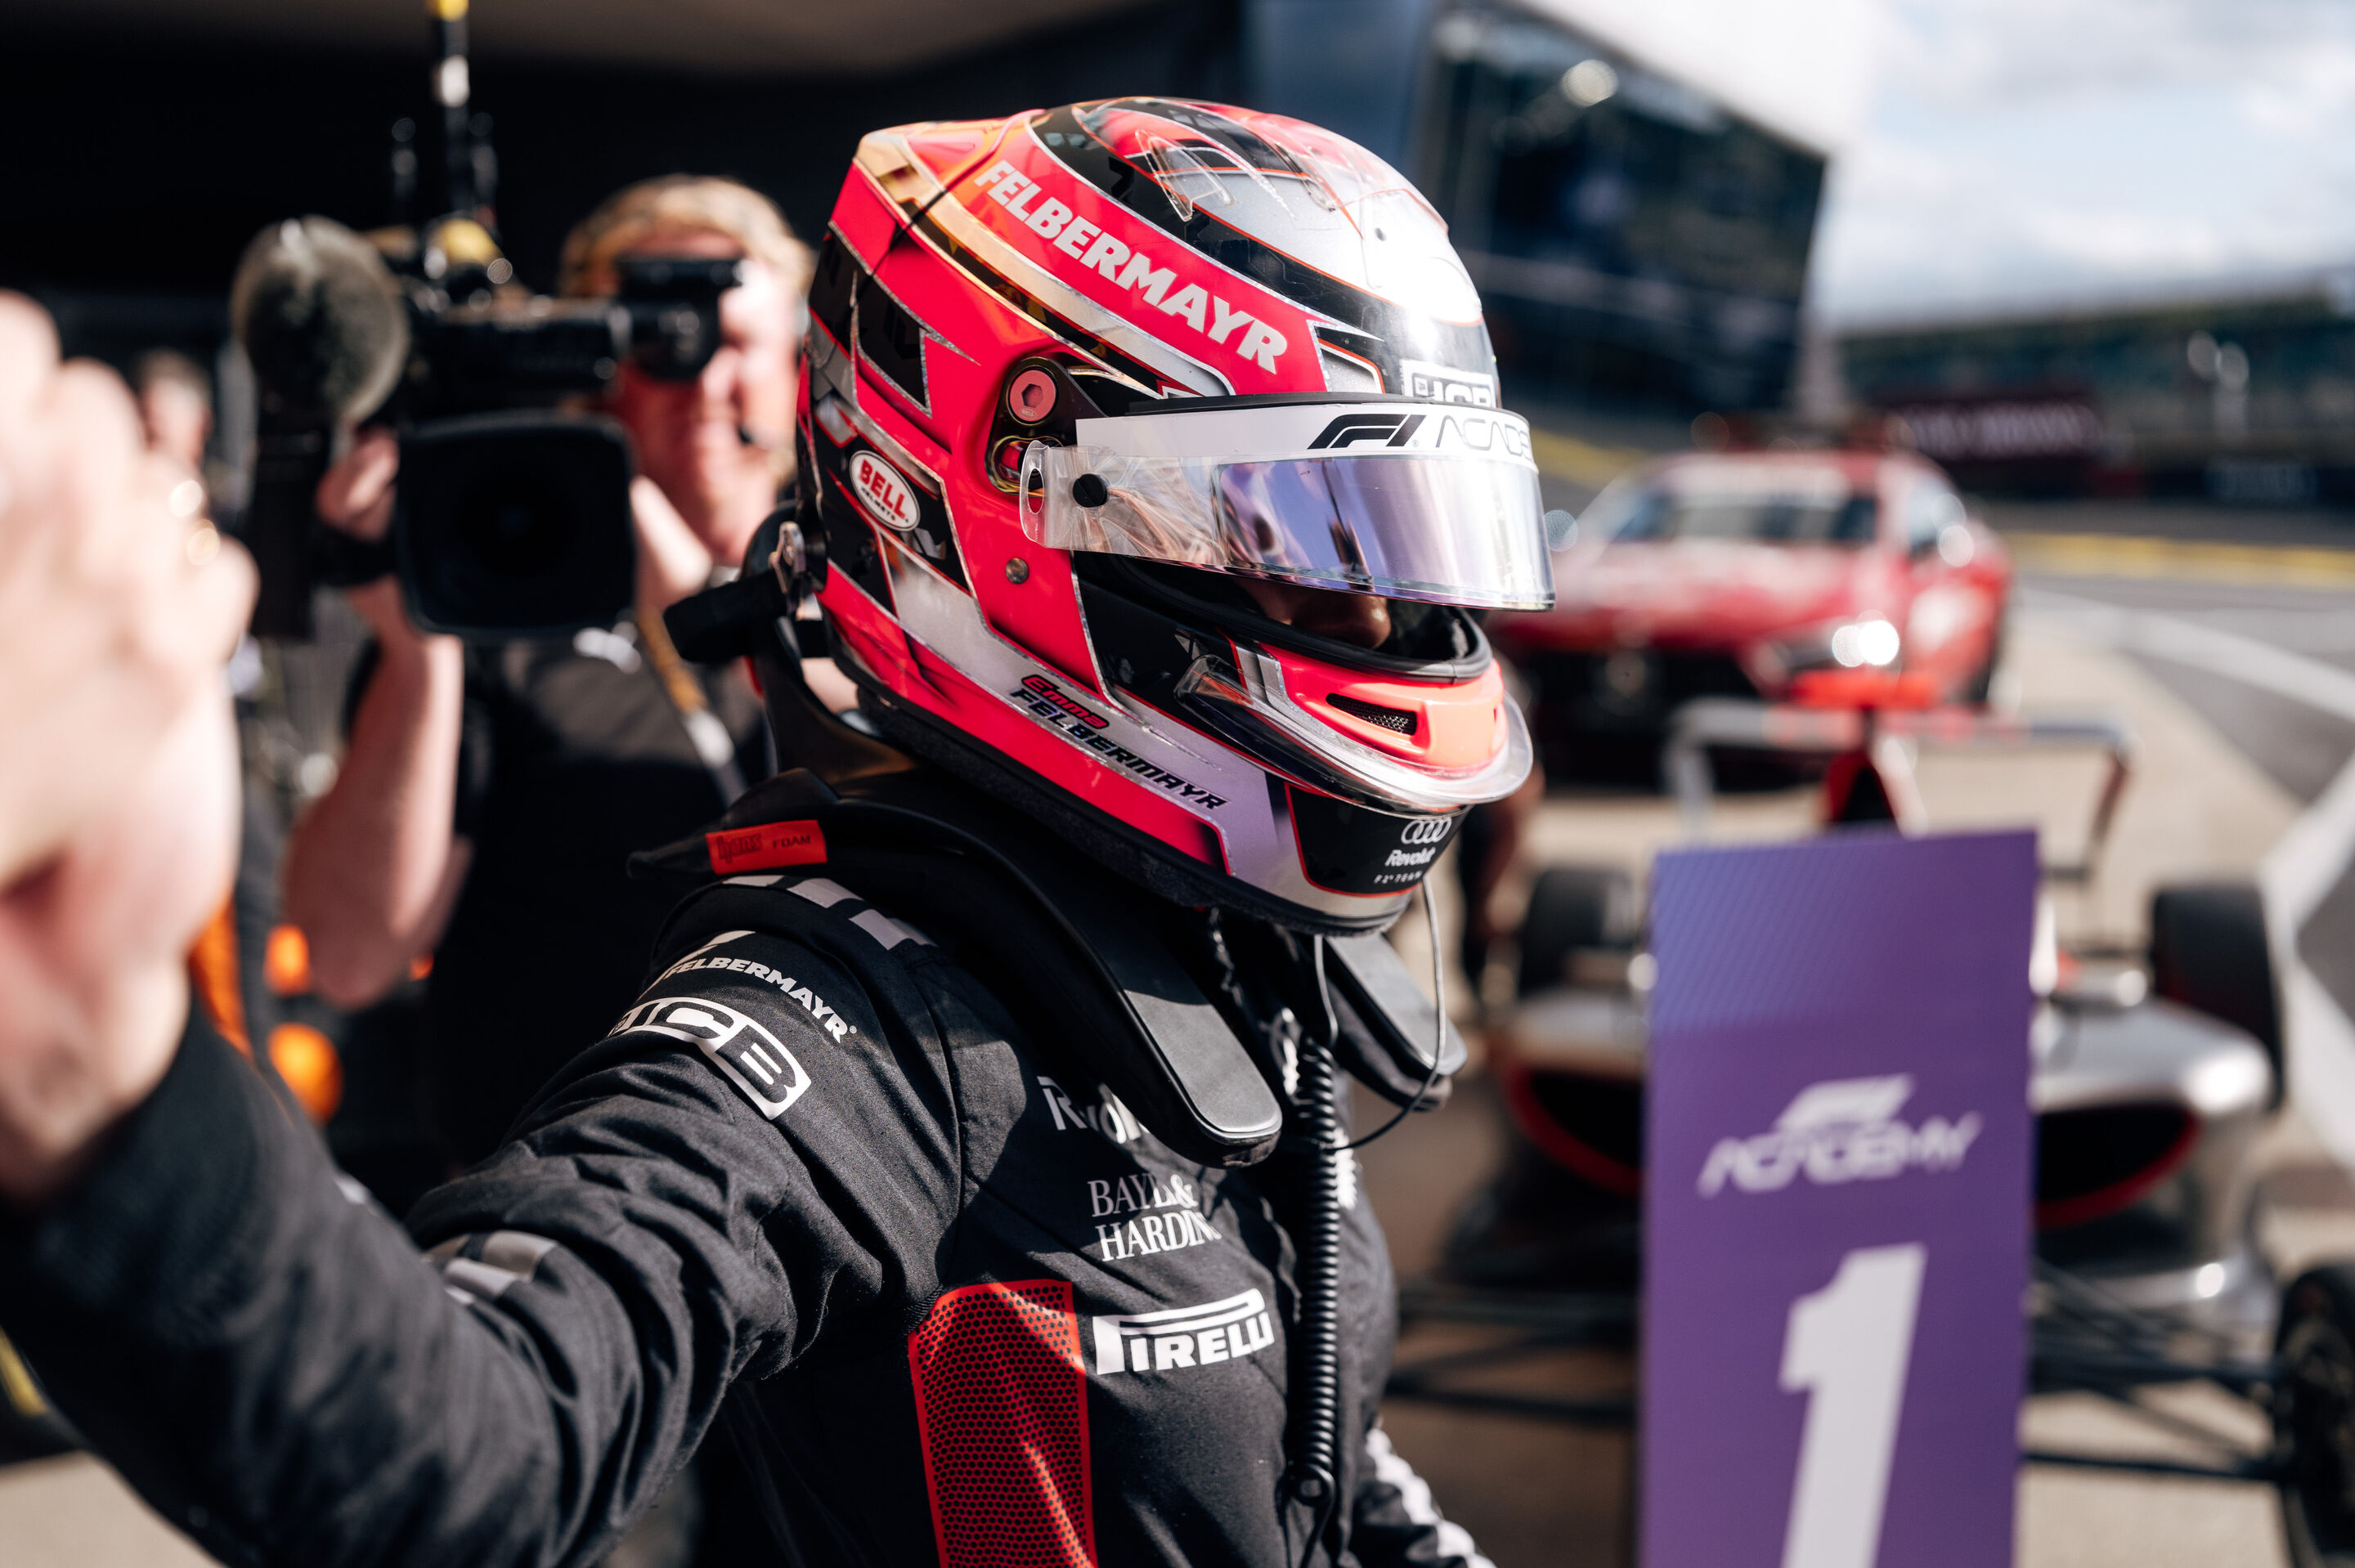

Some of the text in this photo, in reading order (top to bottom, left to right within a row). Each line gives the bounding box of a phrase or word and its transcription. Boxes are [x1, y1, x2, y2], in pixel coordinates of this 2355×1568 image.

[974, 160, 1287, 374] FELBERMAYR
[1307, 413, 1532, 461] F1 ACADE
[859, 459, 905, 520] BELL
[1021, 674, 1110, 729] Emma
[1010, 688, 1229, 809] FELBERMAYR
[662, 956, 848, 1044] FELBERMAYR
[1170, 1174, 1199, 1209] &
[1095, 1209, 1222, 1261] HARDIN
[1092, 1288, 1275, 1375] PIRELLI
[1780, 1240, 1928, 1568] 1
